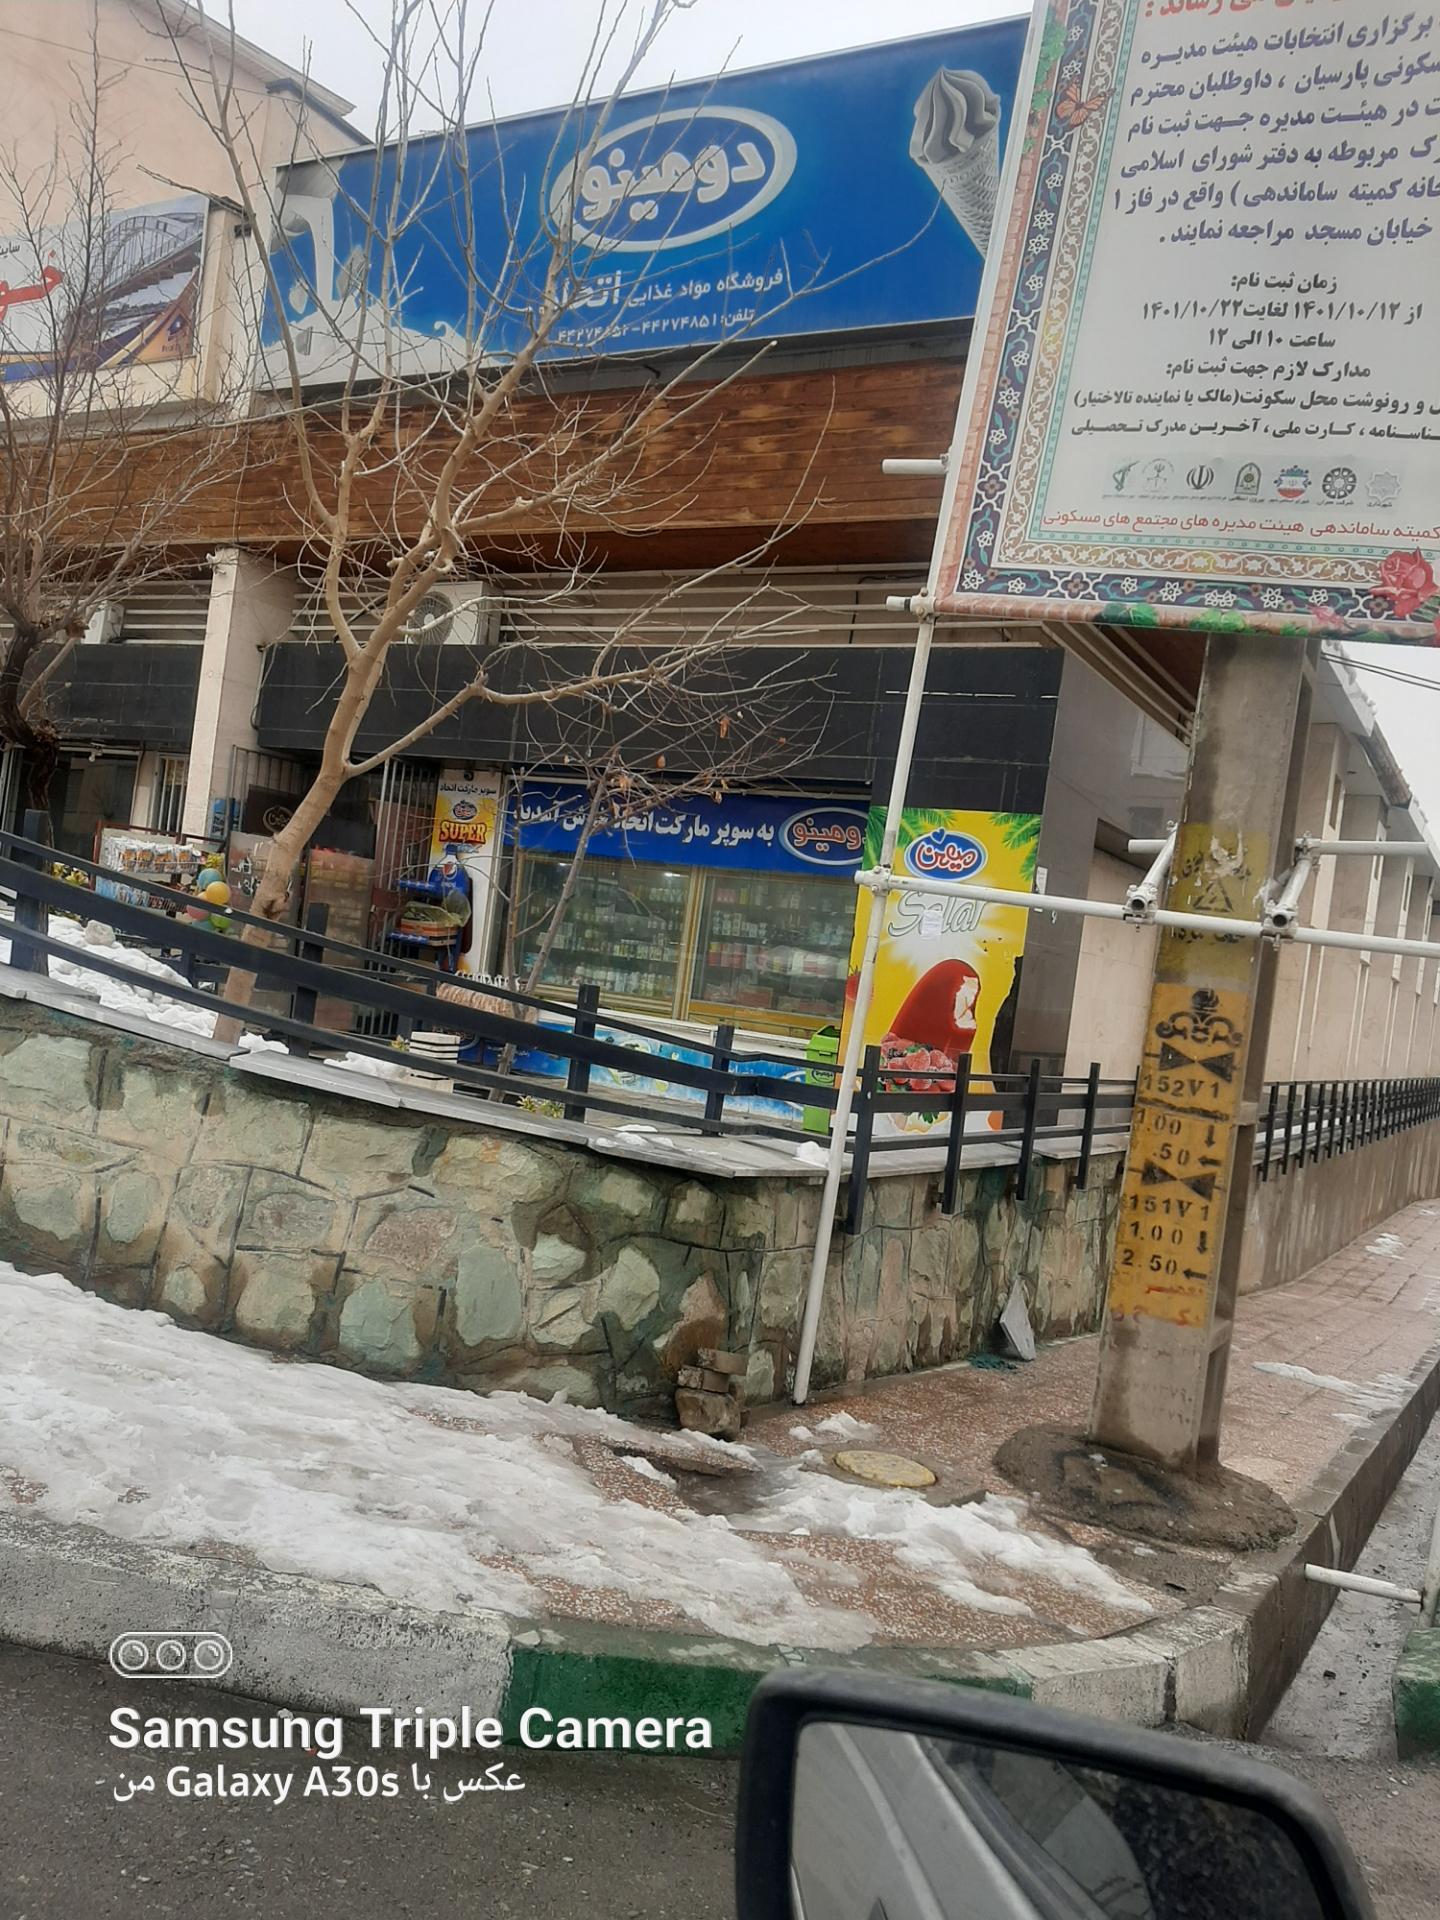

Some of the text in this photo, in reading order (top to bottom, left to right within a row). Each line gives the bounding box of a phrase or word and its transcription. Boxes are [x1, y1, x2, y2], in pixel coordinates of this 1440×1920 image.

[1141, 11, 1433, 69] برگزاری انتخابات هیئت مدیره
[1295, 59, 1369, 94] پارسیان
[1374, 51, 1440, 86] سکونی
[1131, 82, 1185, 106] محترم
[1190, 68, 1271, 101] داوطلبان
[1158, 112, 1191, 136] ثبت
[1195, 111, 1254, 132] جهت
[1259, 111, 1314, 132] مدیره
[1320, 101, 1387, 128] هیئت
[1391, 100, 1419, 127] در
[1128, 117, 1153, 141] نام
[1120, 149, 1185, 178] اسلامی
[1192, 144, 1253, 173] شورای
[1256, 143, 1298, 171] دفتر
[1304, 146, 1322, 169] به
[1328, 139, 1399, 169] مربوطه
[580, 142, 767, 220] دومینو
[1349, 179, 1403, 206] کمیته
[1125, 186, 1152, 214] فاز
[1155, 190, 1179, 213] در
[1184, 181, 1223, 211] واقع
[1228, 220, 1295, 246] مراجعه
[1304, 221, 1362, 246] مسجد
[1367, 216, 1433, 246] خیابان
[680, 279, 711, 299] مواد
[716, 268, 784, 292] فروشگاه
[1230, 271, 1337, 294] زمان ثبت نام:
[627, 284, 673, 308] غذایی
[1404, 302, 1423, 325] از
[1209, 327, 1336, 349] ساعت ۱۰ الی ۱۲
[1166, 357, 1371, 382] مدارک لازم جهت ثبت نام:
[1135, 390, 1181, 407] نماینده
[1184, 390, 1194, 407] یا
[1300, 390, 1338, 410] محل
[1342, 392, 1410, 414] رونوشت
[1413, 400, 1425, 415] و
[1071, 418, 1143, 435] تحصیلی
[1146, 419, 1187, 436] مدرک
[1189, 418, 1260, 436] آخرین
[1272, 421, 1301, 438] ملی
[1305, 422, 1356, 439] کارت
[1369, 424, 1440, 440] ناسنامه
[1043, 510, 1440, 541] کمیته ساماندهی هیئت مدیره های مجتمع های مسکونی
[440, 821, 486, 843] SUPER
[654, 814, 709, 844] مارکت
[712, 823, 754, 846] سوپر
[756, 819, 774, 847] به
[792, 817, 867, 852] ومینو
[915, 842, 978, 872] میهن
